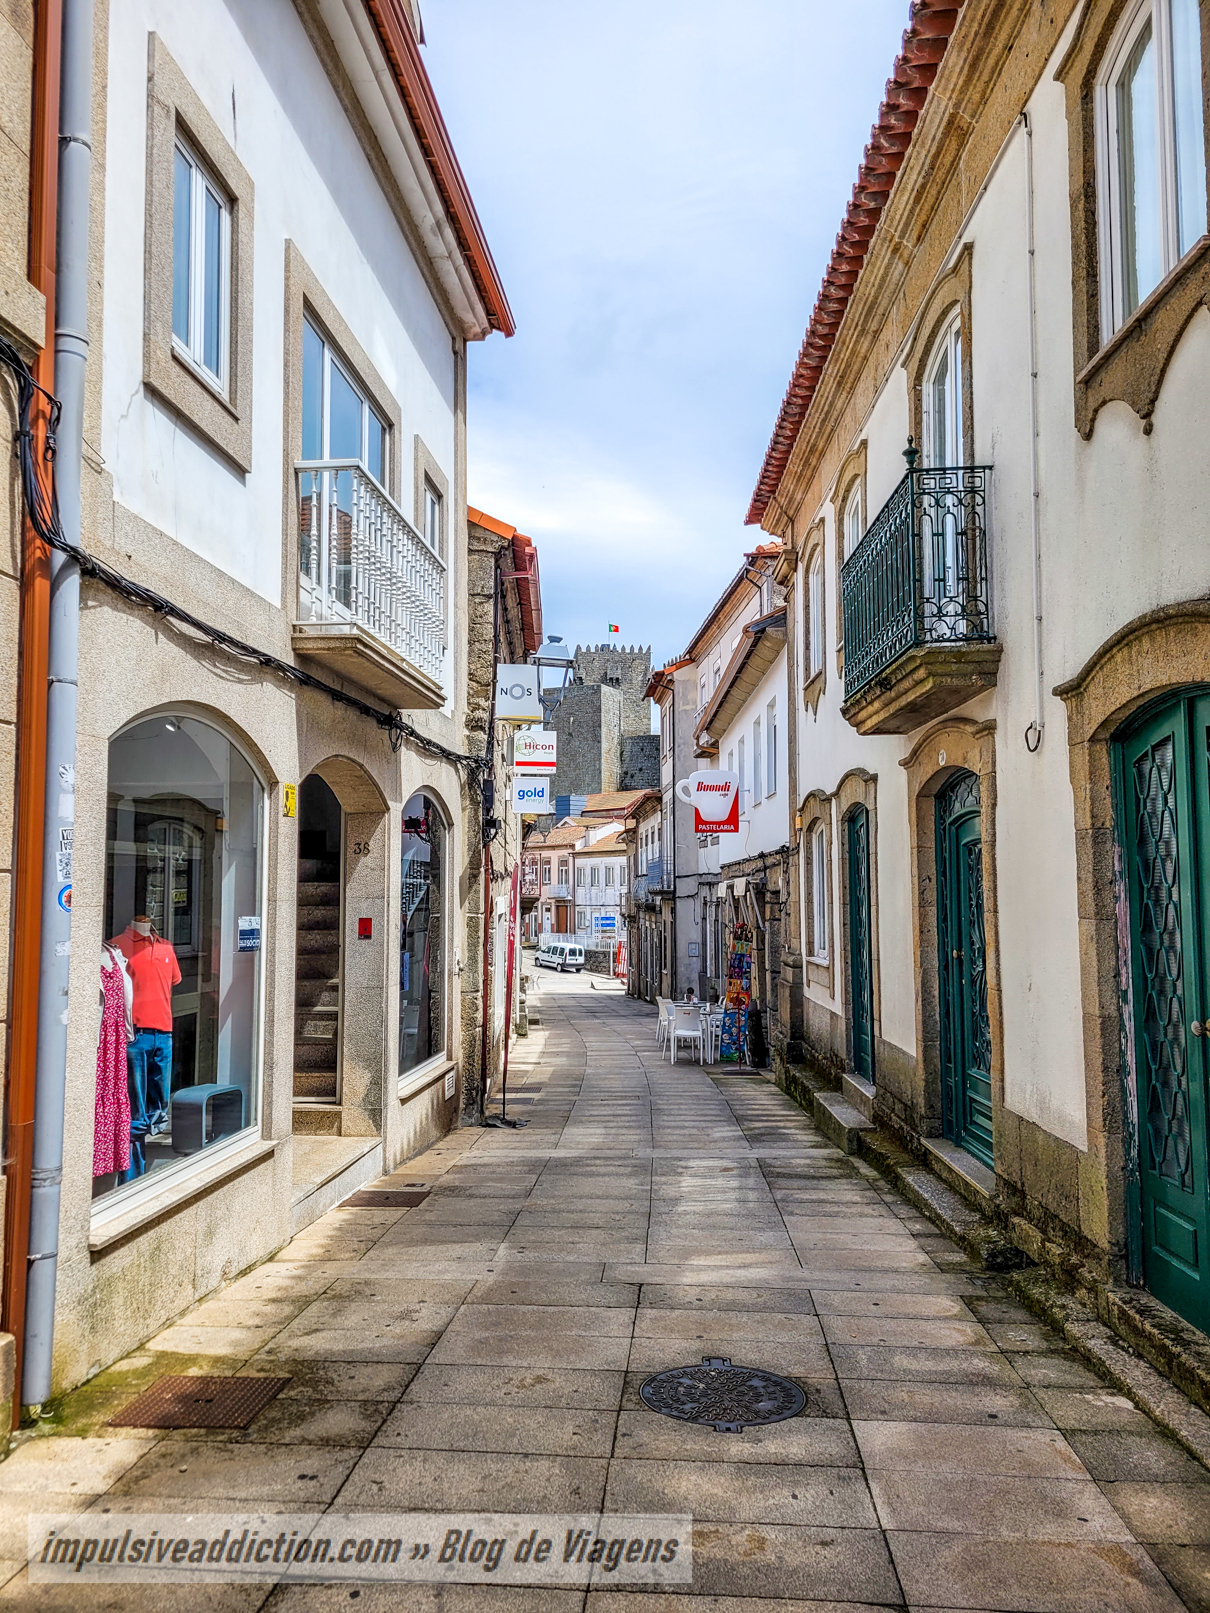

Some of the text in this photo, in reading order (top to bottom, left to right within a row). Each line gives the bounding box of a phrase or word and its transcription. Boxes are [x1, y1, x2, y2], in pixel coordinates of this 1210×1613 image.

[500, 683, 532, 700] NOS
[524, 742, 554, 750] Hicon
[696, 781, 731, 792] Buondi
[517, 787, 545, 800] gold
[354, 842, 370, 855] 38
